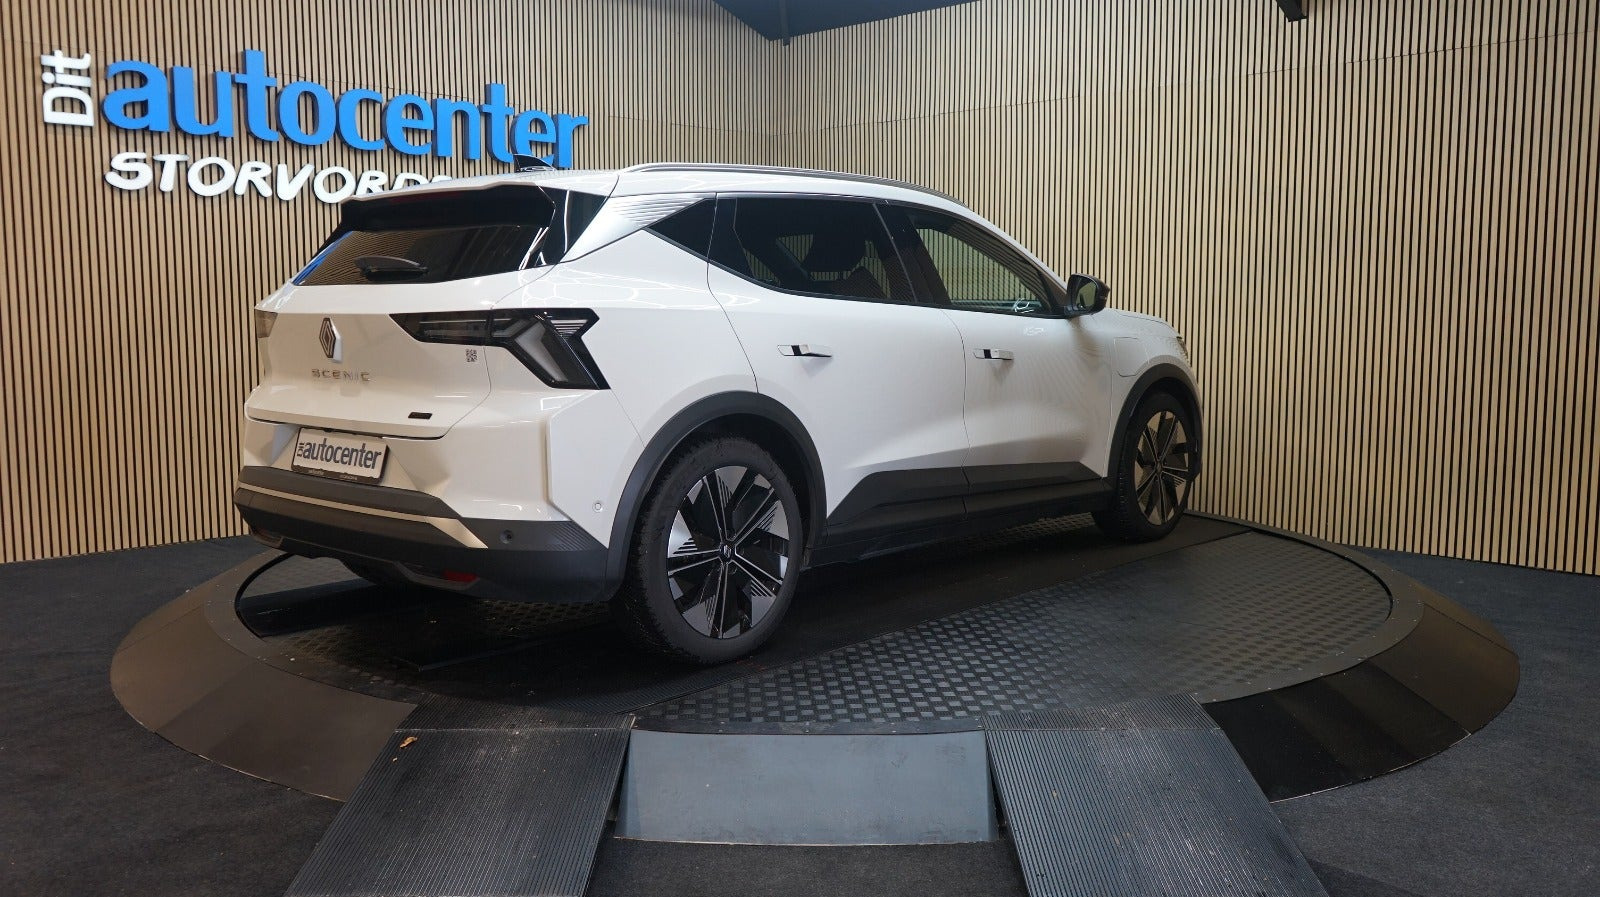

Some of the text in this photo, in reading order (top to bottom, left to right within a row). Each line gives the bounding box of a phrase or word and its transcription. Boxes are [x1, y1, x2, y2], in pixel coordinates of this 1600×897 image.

[40, 48, 589, 169] Dit autocenter
[104, 151, 453, 204] STORVOR
[311, 368, 371, 382] SCENIC
[303, 437, 382, 470] autocenter
